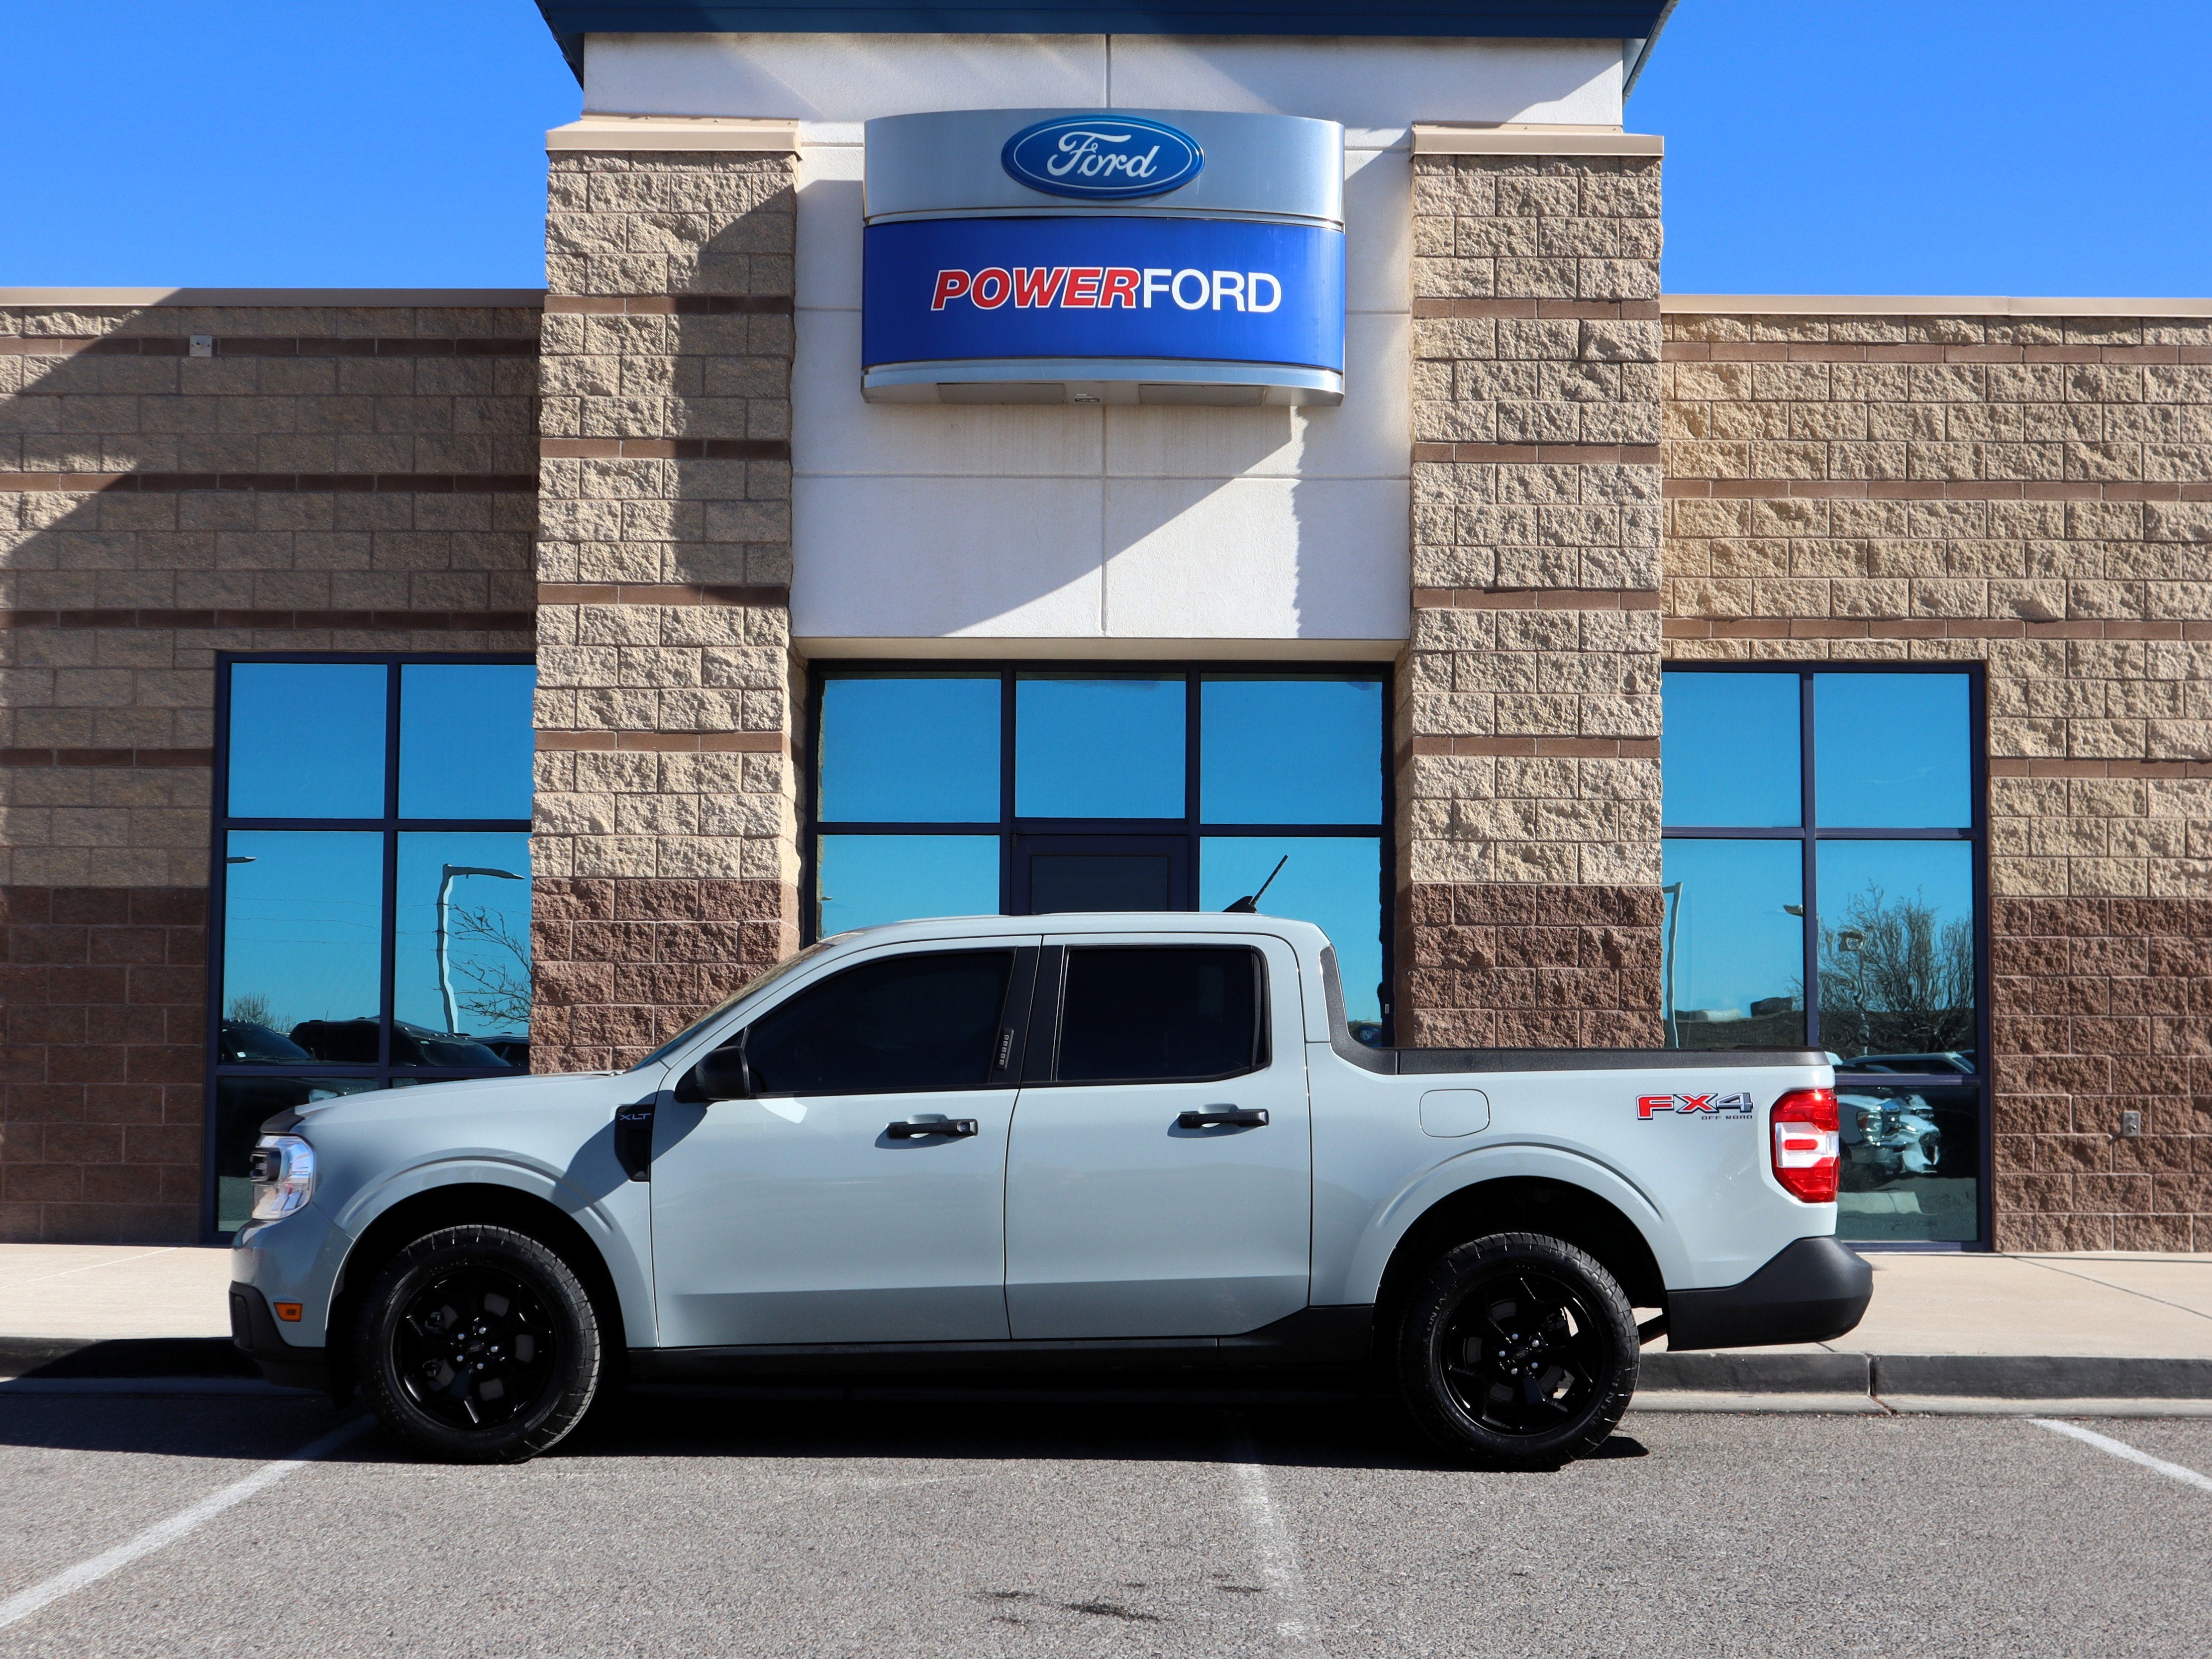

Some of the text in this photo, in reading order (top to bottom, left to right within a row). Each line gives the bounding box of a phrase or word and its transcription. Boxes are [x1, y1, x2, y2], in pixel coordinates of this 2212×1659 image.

[1047, 132, 1160, 178] Ford
[930, 267, 1282, 313] POWERFORD
[1636, 1092, 1753, 1120] FX4
